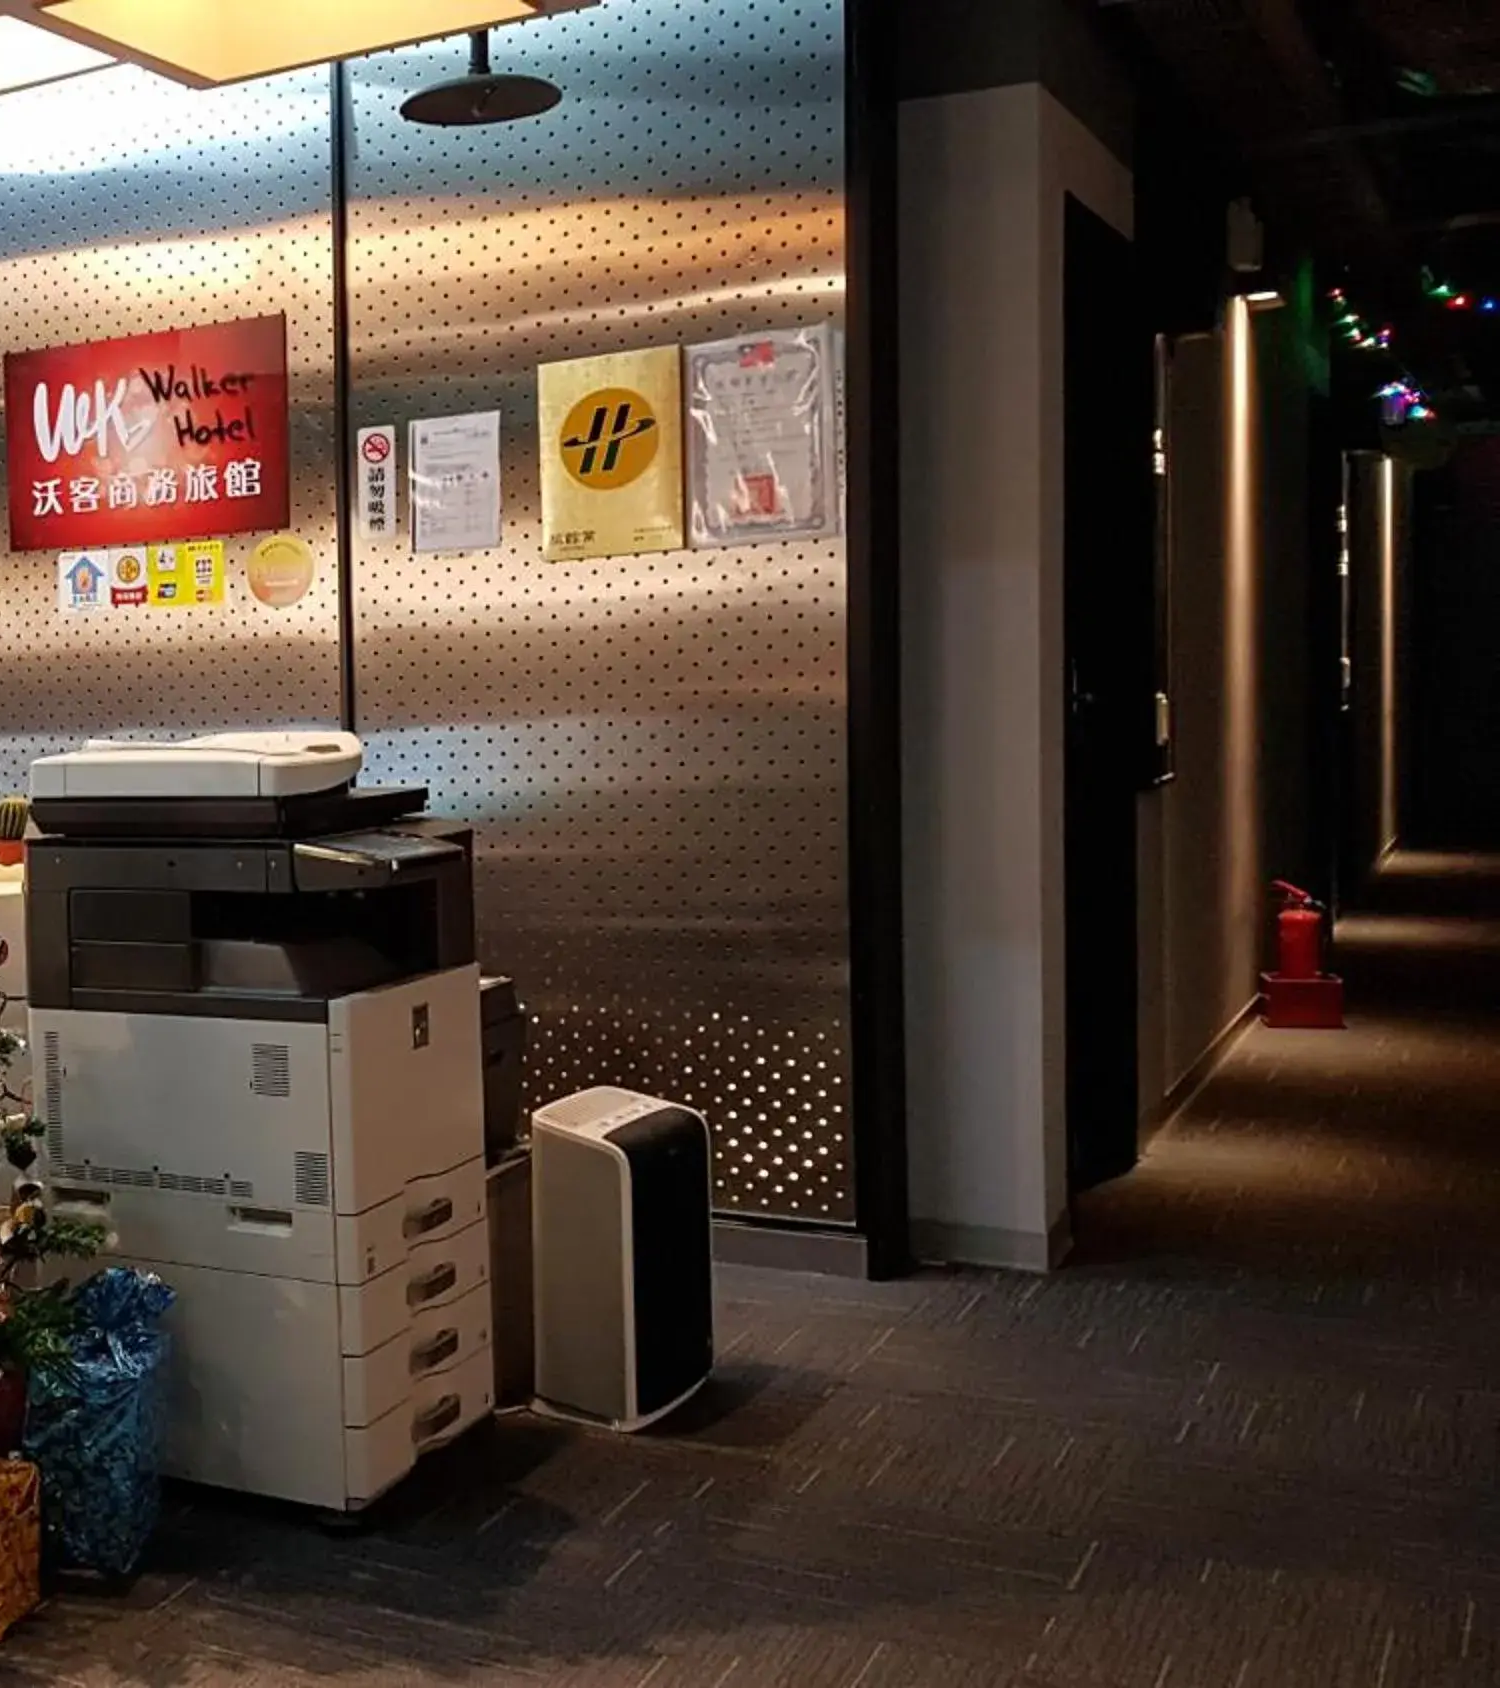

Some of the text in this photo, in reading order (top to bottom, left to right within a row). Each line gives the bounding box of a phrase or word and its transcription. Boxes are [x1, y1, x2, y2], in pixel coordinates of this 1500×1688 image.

[138, 364, 253, 403] Walker
[173, 406, 256, 447] Hotel
[32, 457, 262, 517] 沃客商務旅館
